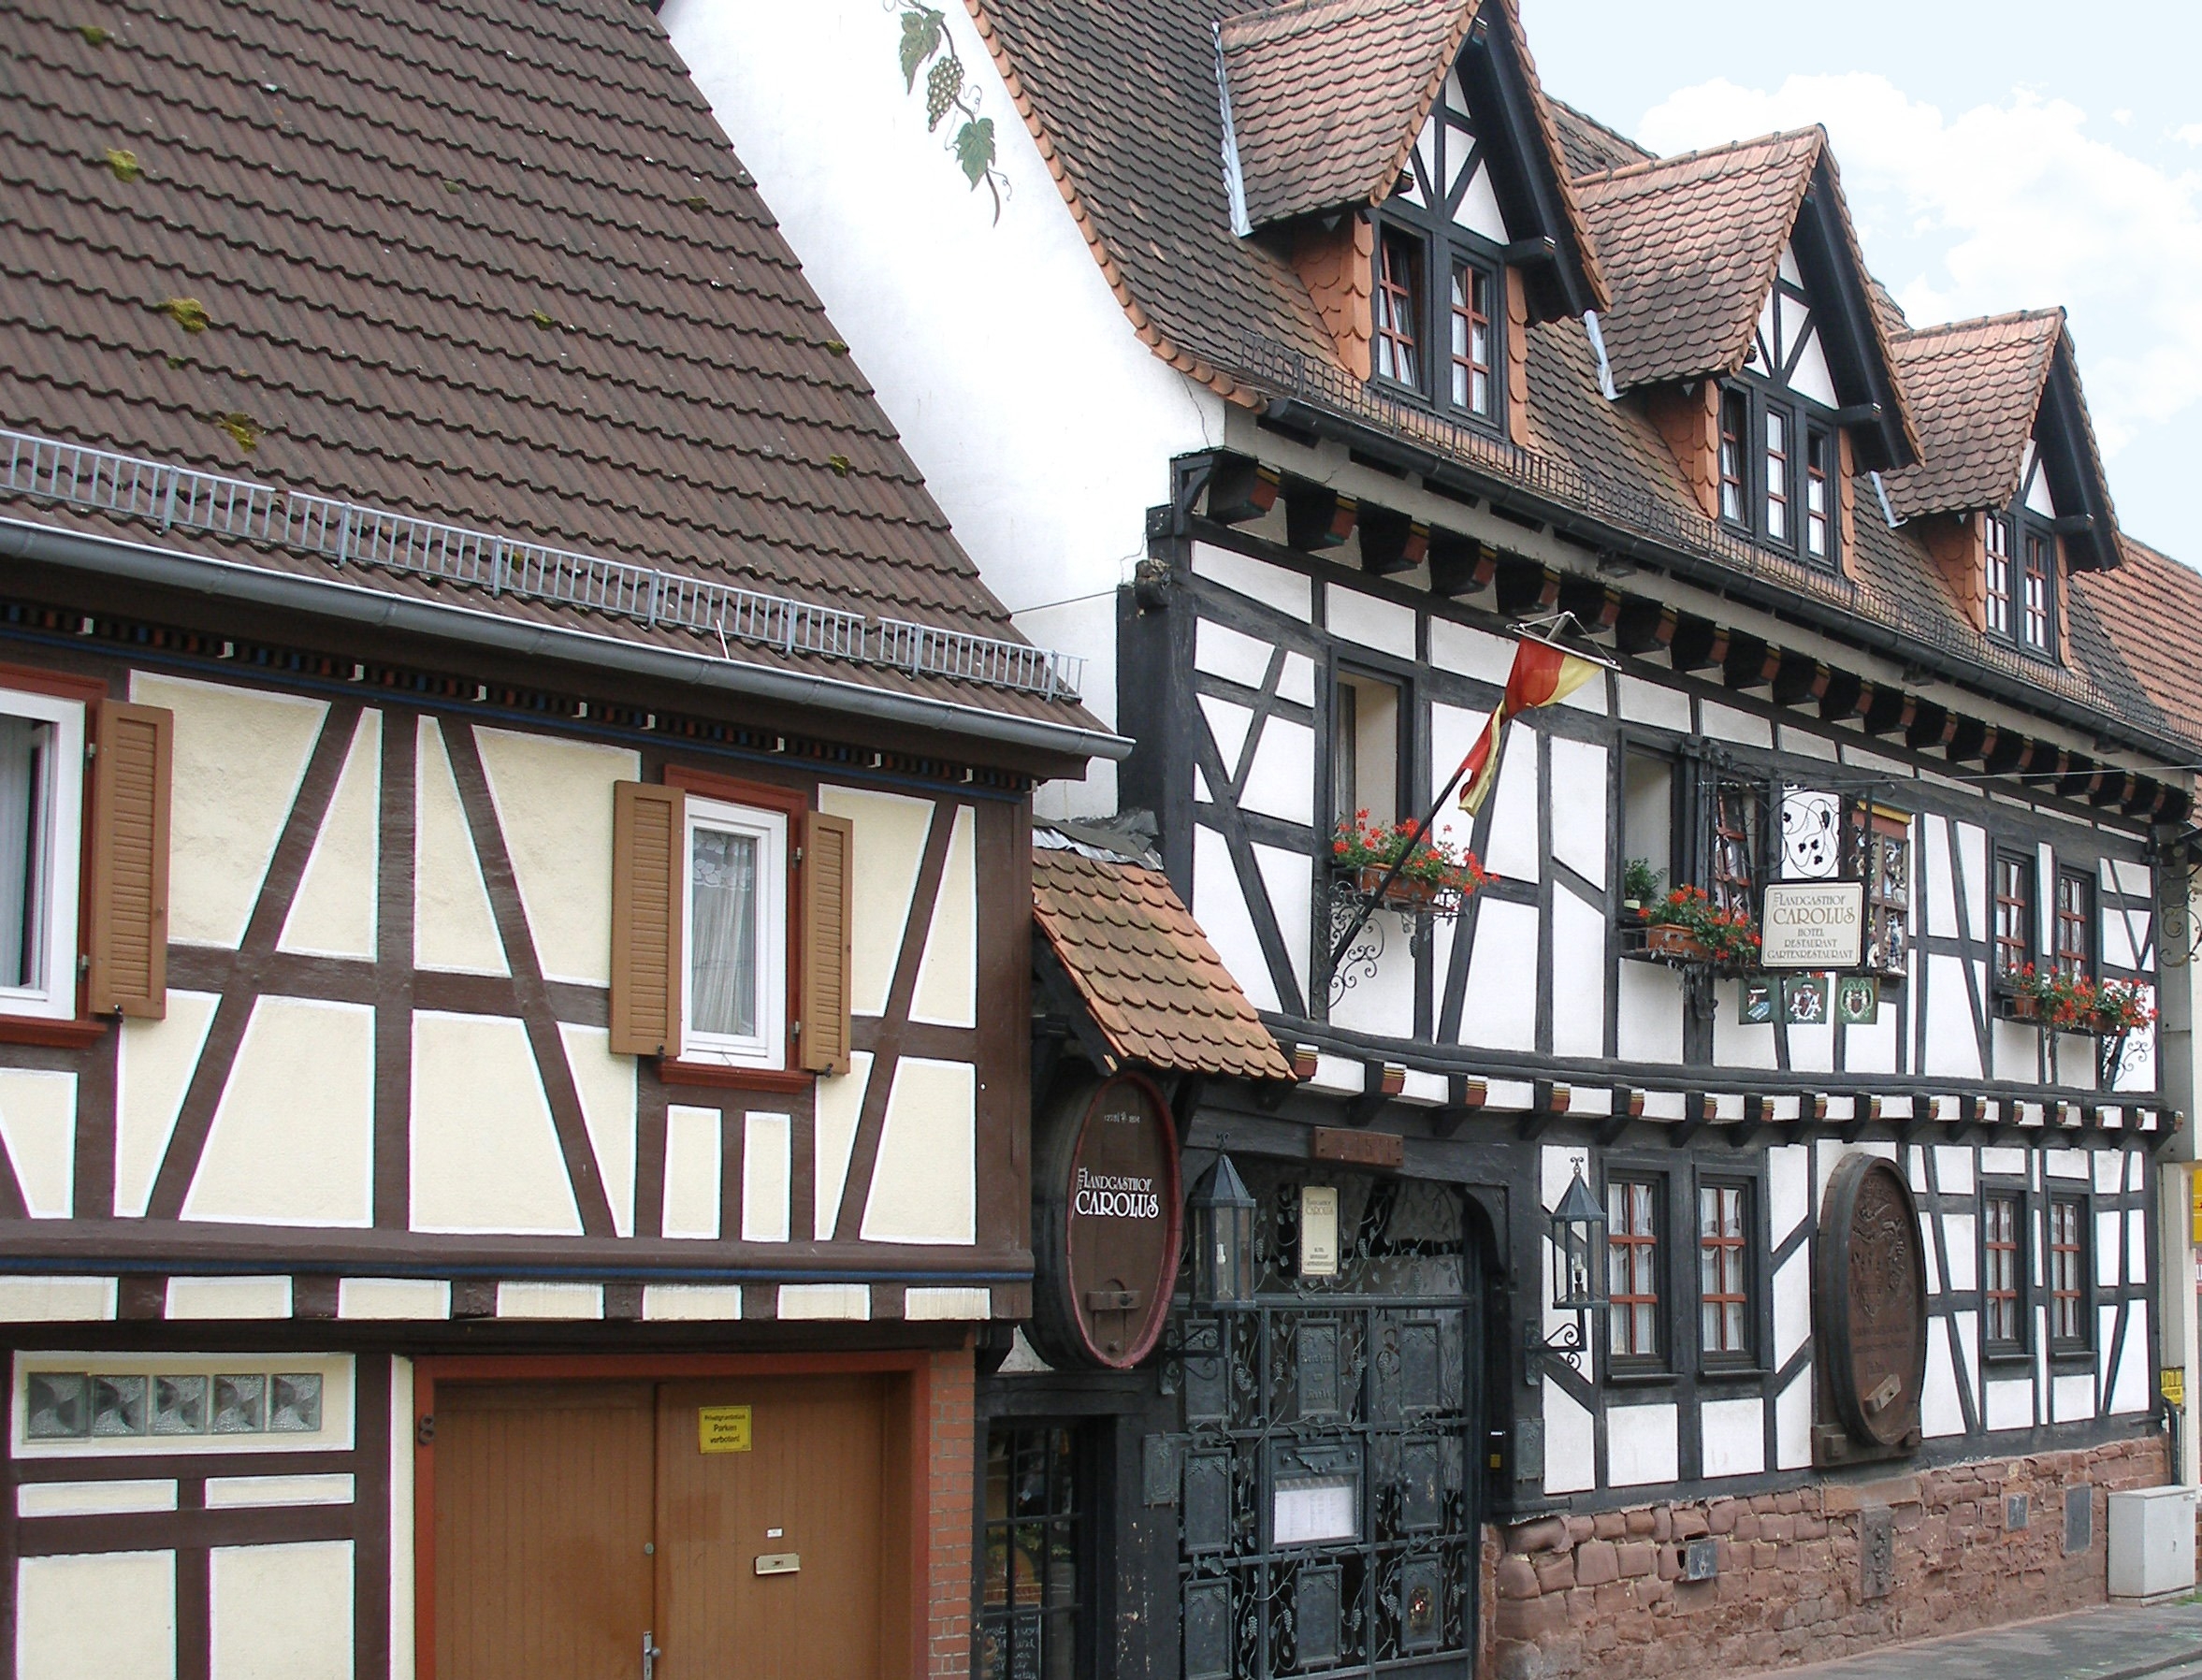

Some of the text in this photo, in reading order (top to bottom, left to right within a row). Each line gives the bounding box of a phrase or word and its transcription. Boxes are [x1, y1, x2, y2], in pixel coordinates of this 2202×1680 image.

[1779, 893, 1846, 906] LANDGASTHOF
[1773, 907, 1855, 925] CAROLUS
[1797, 928, 1825, 937] HOTEL
[1784, 938, 1838, 949] RESTAURANT
[1767, 949, 1854, 959] GARTENRESTAURANT
[1083, 1171, 1152, 1192] LANDGASTHOF
[1076, 1190, 1159, 1219] CAROLUS
[418, 1413, 435, 1445] 8
[714, 1423, 737, 1431] Parken
